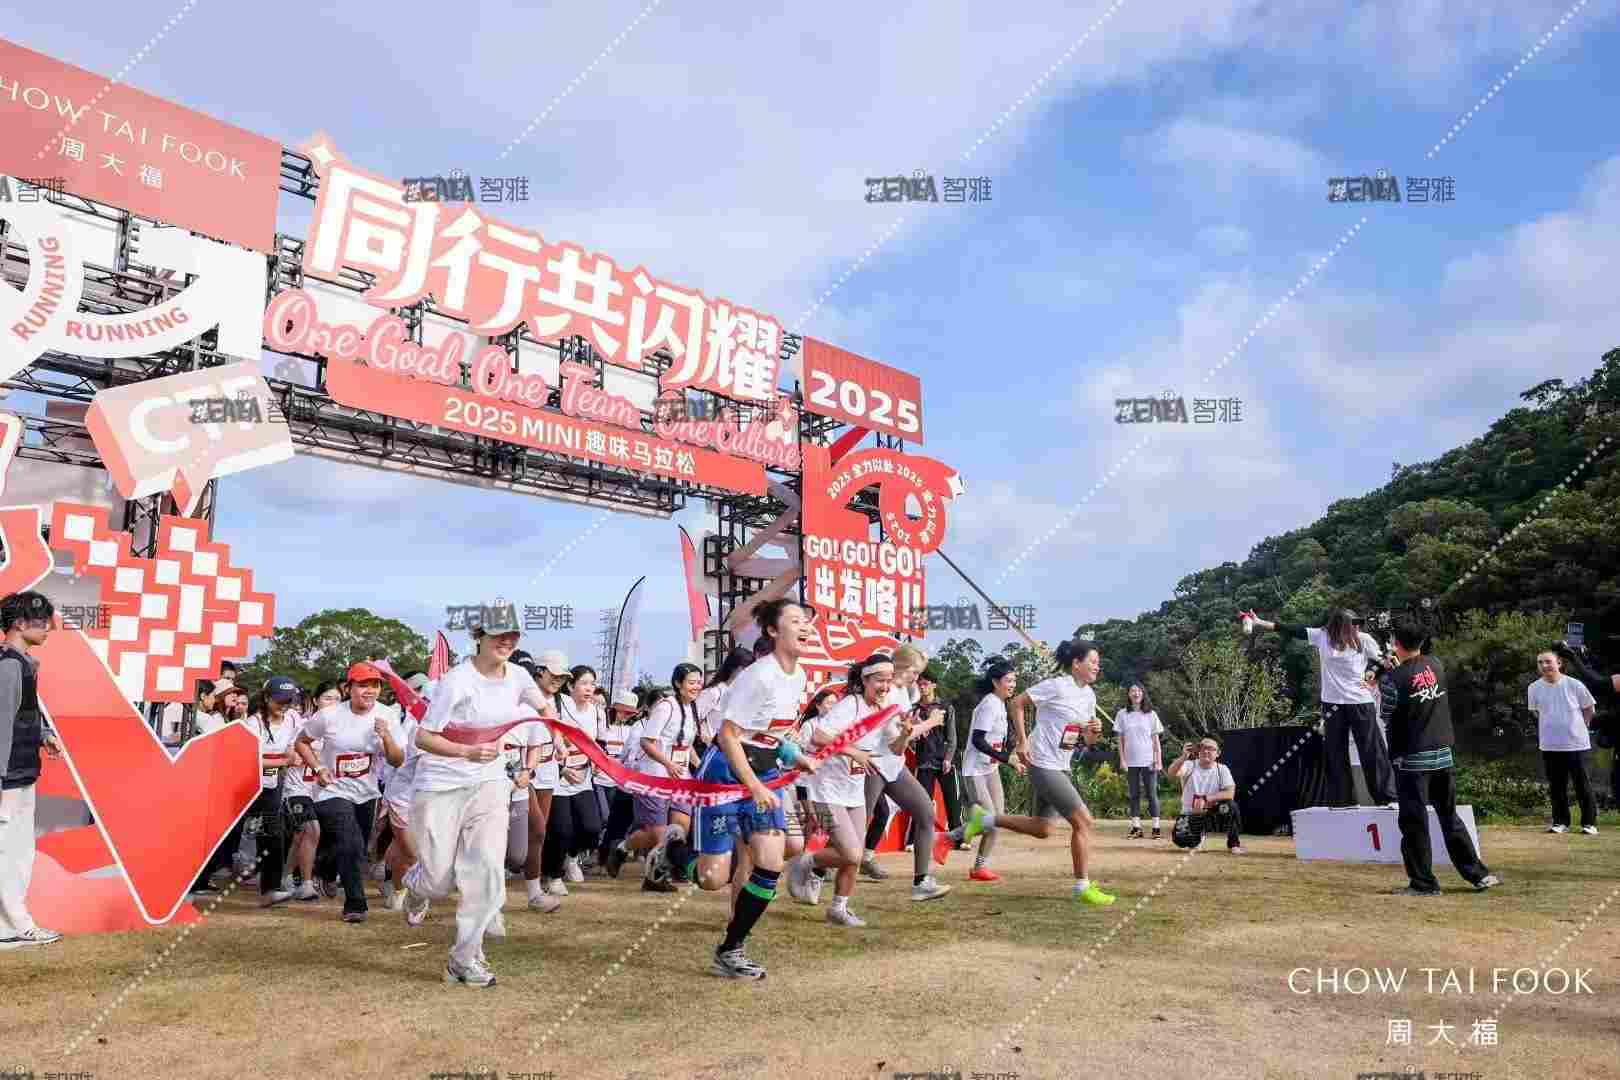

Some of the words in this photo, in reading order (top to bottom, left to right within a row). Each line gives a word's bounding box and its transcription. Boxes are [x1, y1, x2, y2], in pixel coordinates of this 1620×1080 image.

[58, 137, 164, 190] 周大福
[99, 111, 149, 145] TAI
[162, 133, 248, 182] FOOK
[11, 236, 65, 342] RUNNING
[311, 167, 780, 400] 同行共闪耀
[66, 306, 189, 342] RUNNING
[271, 294, 359, 354] One
[370, 320, 458, 378] Goal
[476, 351, 541, 402] One
[562, 364, 635, 425] Team
[809, 369, 919, 433] 2025
[444, 398, 517, 436] 2025
[522, 415, 581, 450] MINI
[585, 430, 696, 475] 趣味马拉松
[806, 535, 840, 562] GO!
[843, 540, 878, 569] GO!
[880, 543, 922, 579] GO!
[1366, 823, 1382, 851] 1
